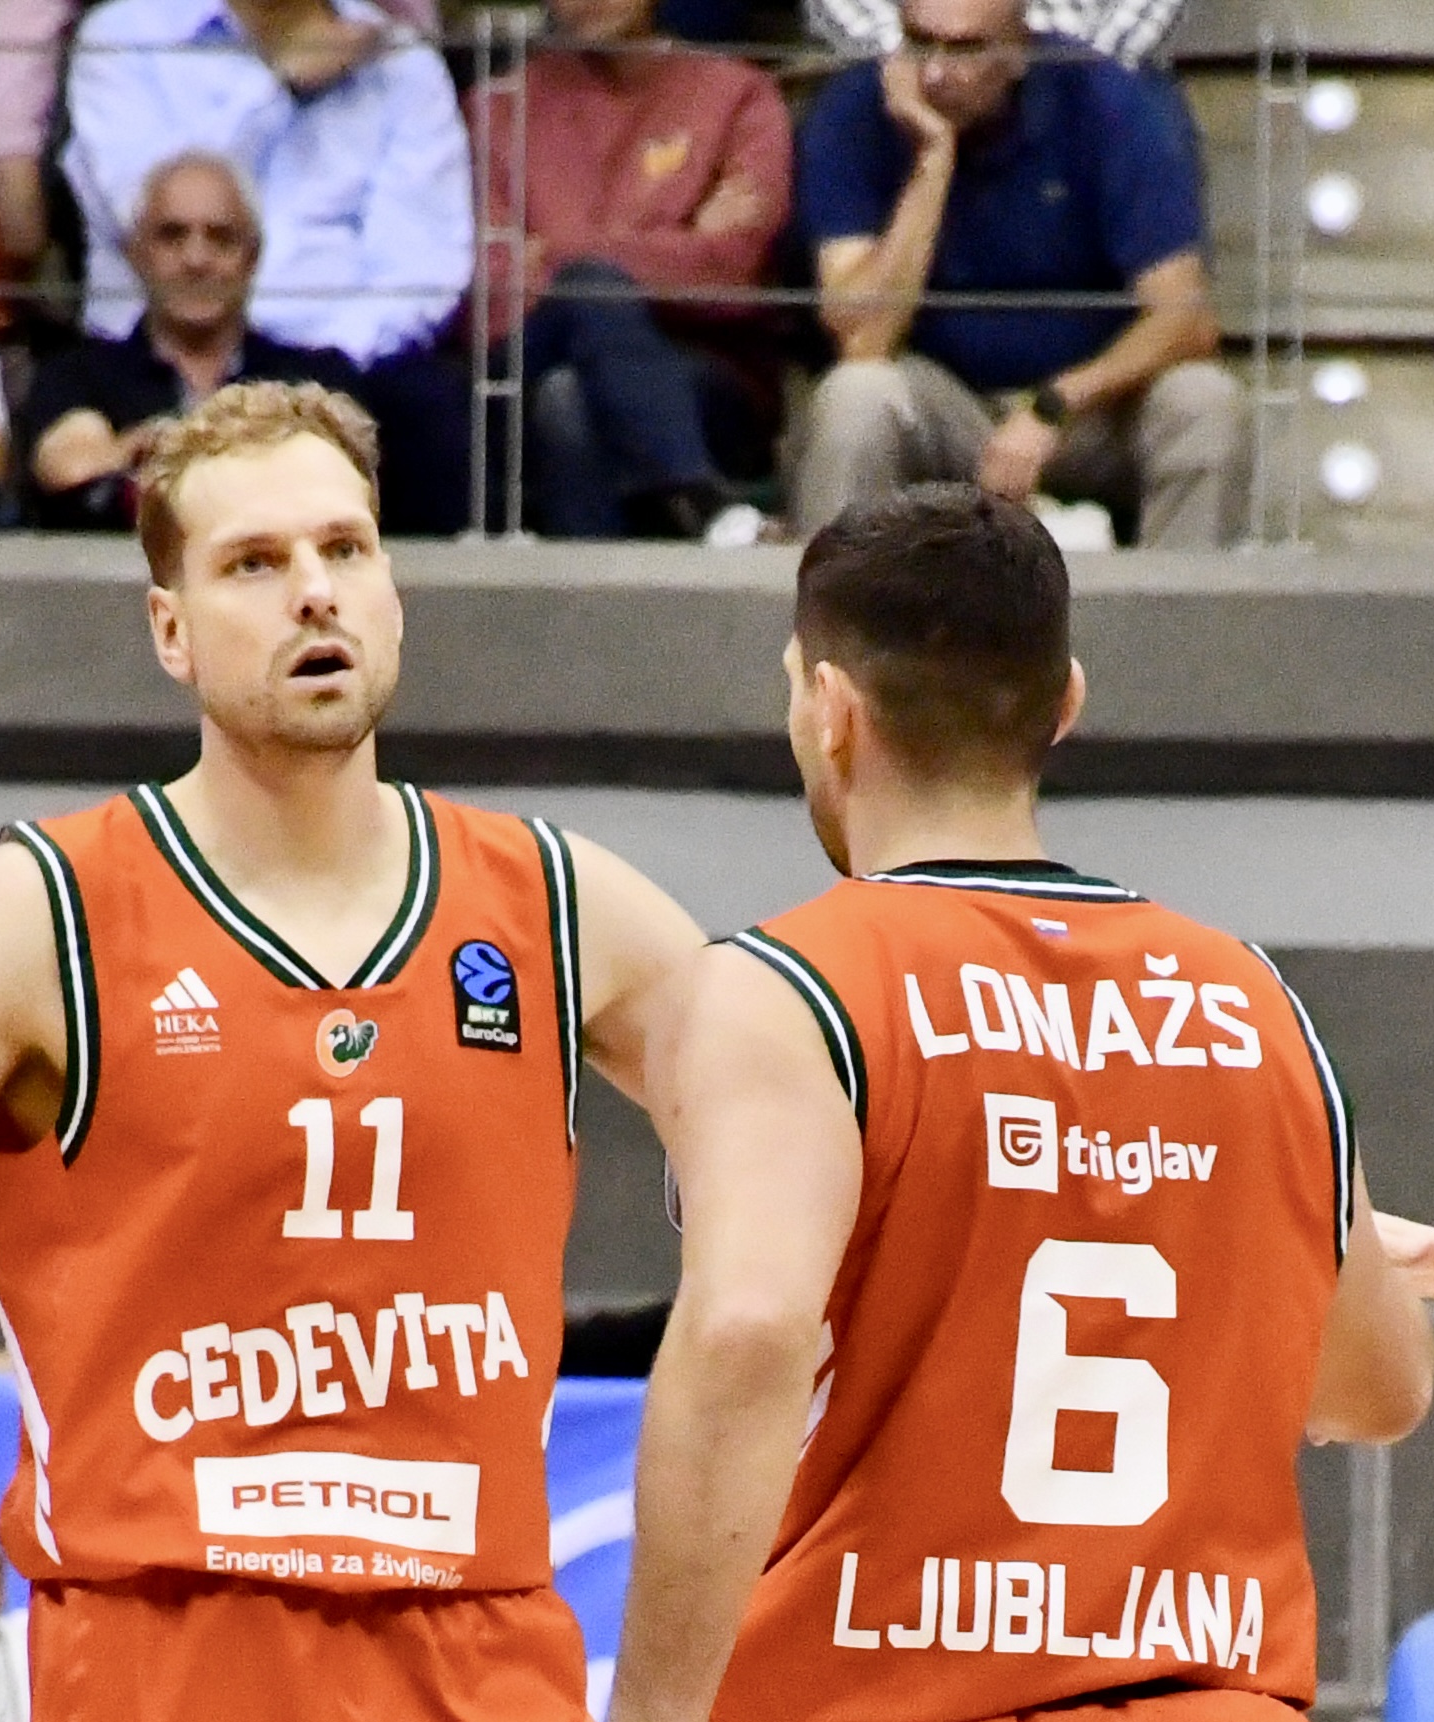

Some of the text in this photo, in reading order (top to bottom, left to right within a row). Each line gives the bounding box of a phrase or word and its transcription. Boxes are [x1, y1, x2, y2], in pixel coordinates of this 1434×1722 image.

[154, 1013, 220, 1034] HEKA
[462, 1023, 518, 1046] EuroCup
[904, 952, 1263, 1071] LOMAŽS
[281, 1097, 414, 1240] 11
[1063, 1125, 1218, 1195] triglav
[133, 1291, 529, 1442] CEDEVITA
[1001, 1238, 1177, 1526] 6
[232, 1480, 450, 1521] PETROL
[206, 1545, 324, 1578] Energija
[331, 1552, 364, 1575] za
[833, 1552, 1263, 1675] LJUBLJANA
